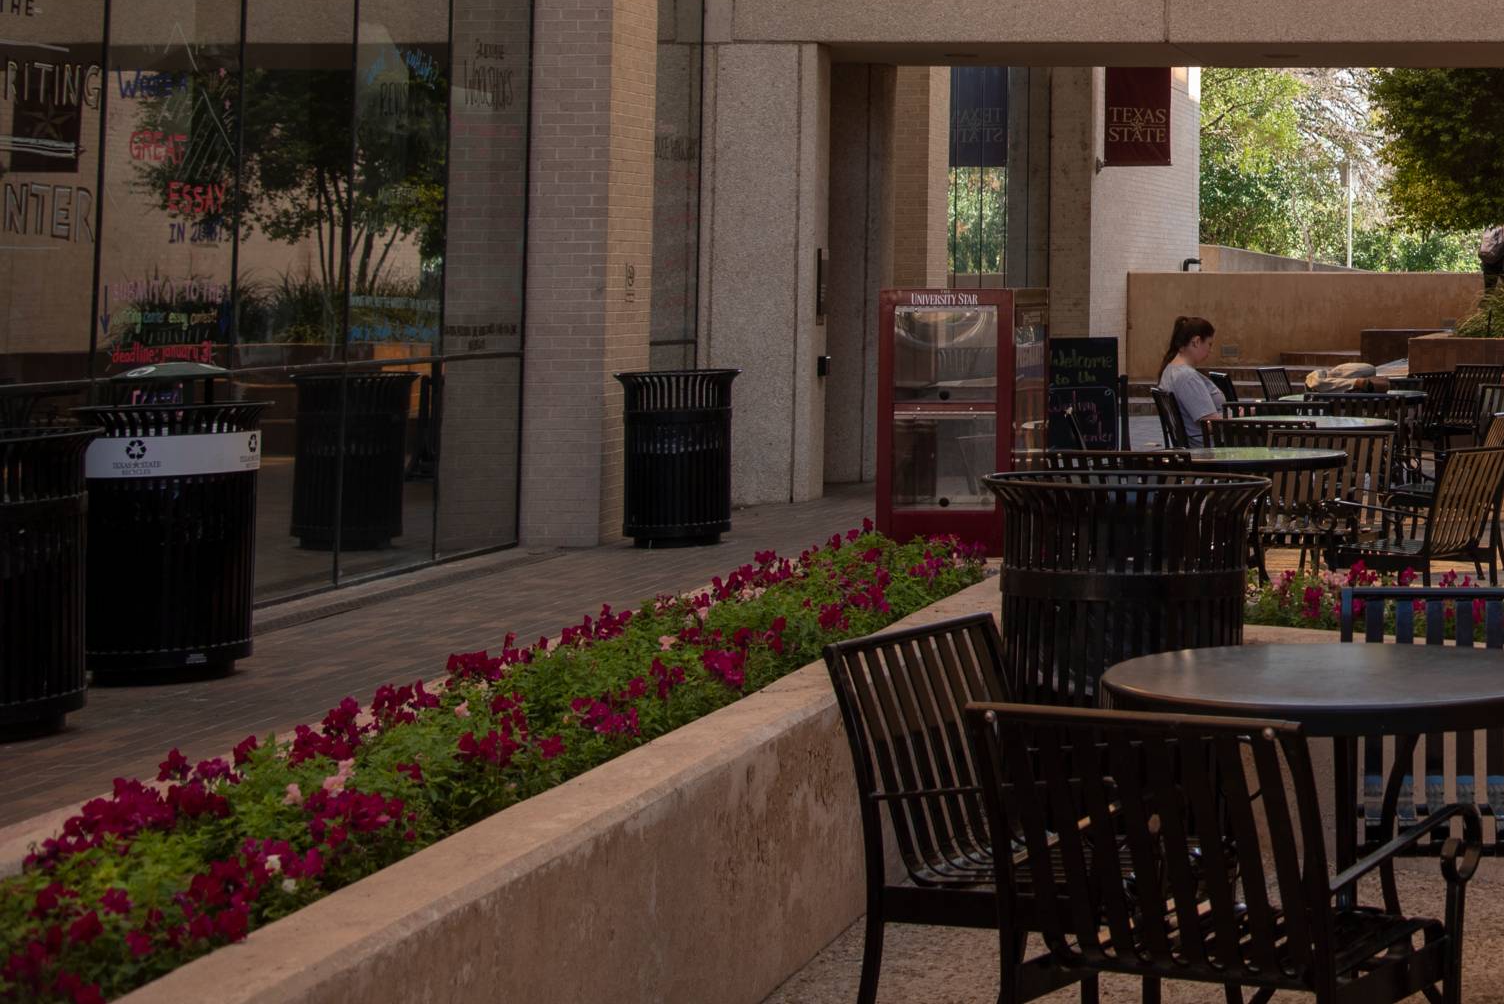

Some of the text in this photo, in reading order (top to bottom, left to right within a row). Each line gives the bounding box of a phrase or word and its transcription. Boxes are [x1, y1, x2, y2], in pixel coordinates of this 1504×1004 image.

[1108, 107, 1167, 124] TEXAS
[1108, 127, 1167, 143] STATE
[130, 129, 189, 164] GREAT
[168, 180, 226, 214] ESSAY
[169, 222, 186, 244] IN
[911, 292, 978, 306] UNIVERSITY STAR
[1055, 373, 1071, 386] to
[112, 460, 161, 469] TEXAS STATE
[121, 468, 152, 476] RECYCLES
